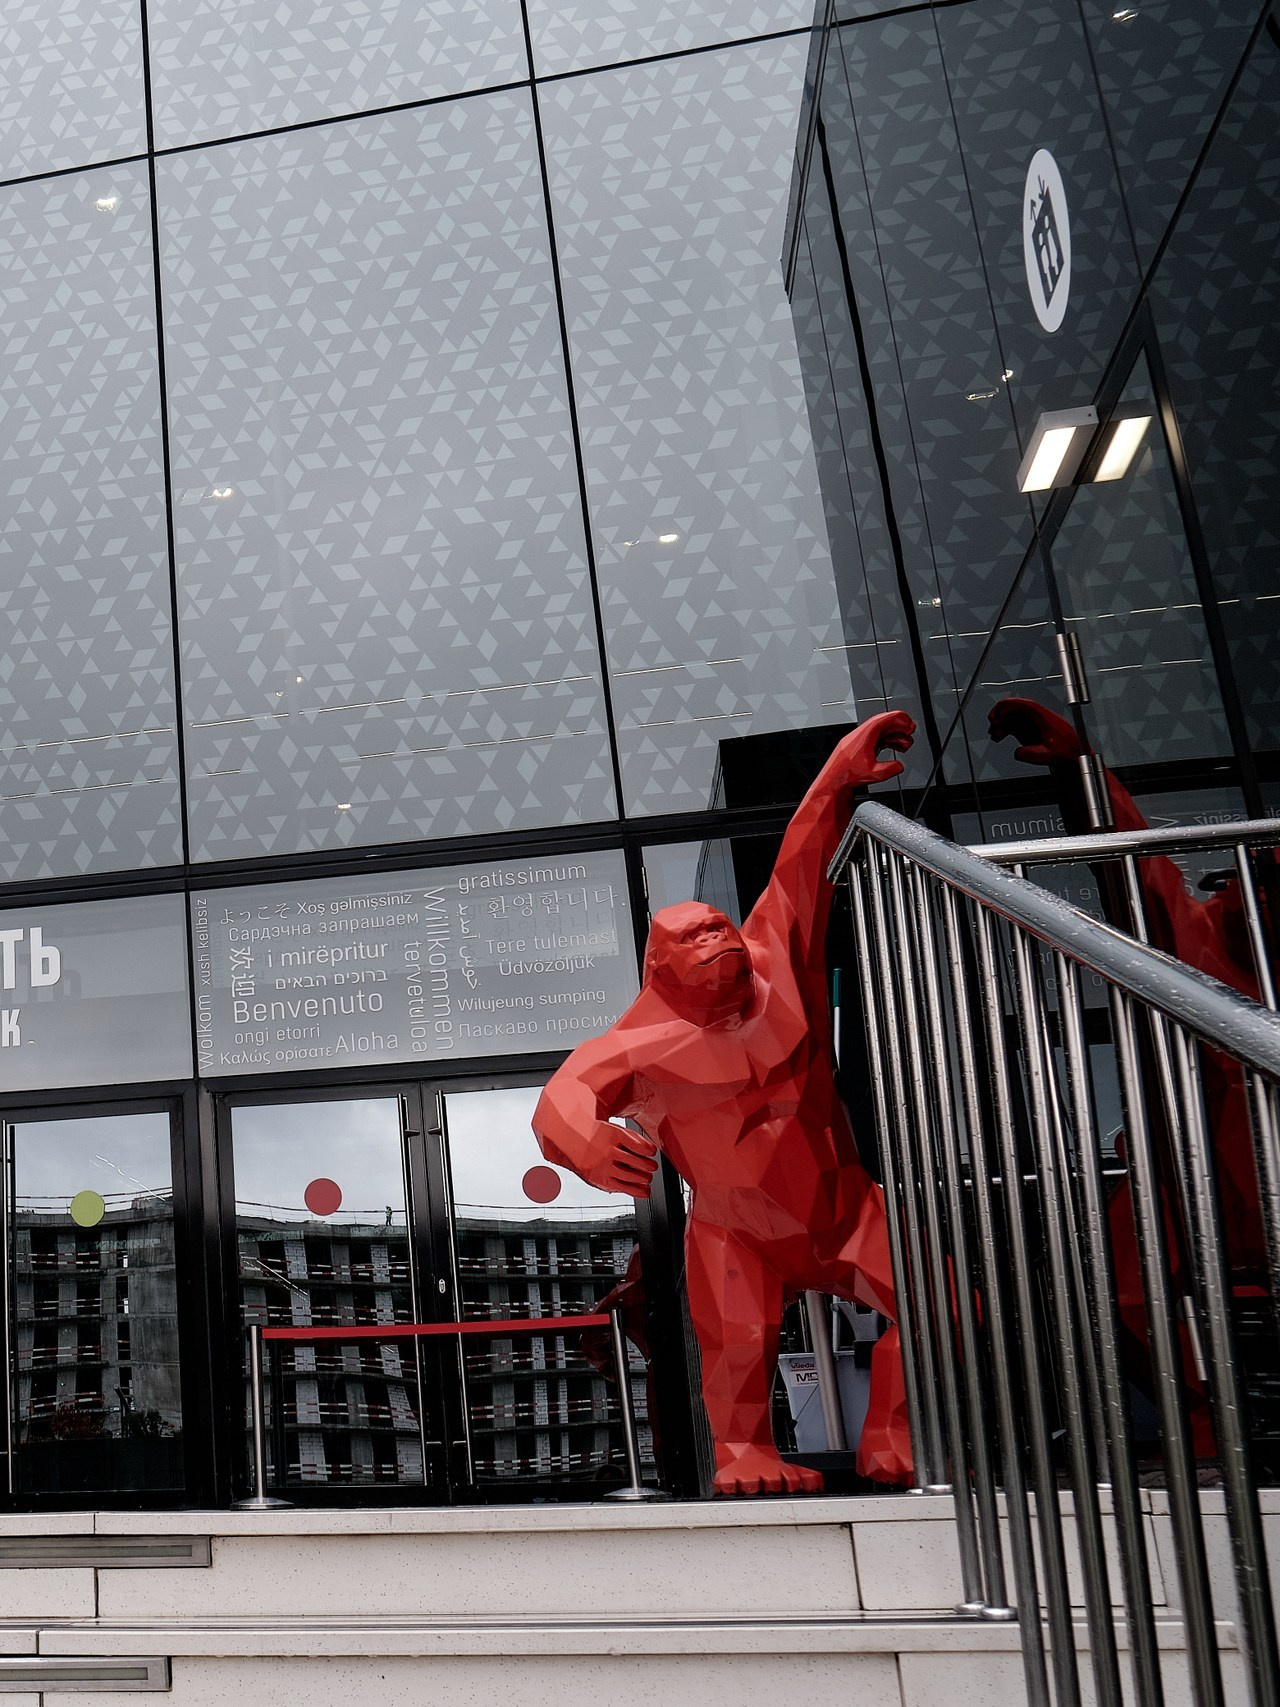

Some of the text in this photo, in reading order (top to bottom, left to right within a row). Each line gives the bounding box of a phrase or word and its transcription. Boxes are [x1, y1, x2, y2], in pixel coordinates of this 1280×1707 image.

[458, 864, 586, 894] gratissimum
[296, 892, 413, 916] Xoş gəlmişsiniz
[229, 912, 419, 943] Сардэчна запрашаем
[485, 928, 618, 954] Tere tulemast
[268, 942, 389, 968] i mirëpritur
[229, 946, 256, 998] 欢迎
[275, 969, 389, 990] ברוכים הבאים
[424, 887, 454, 1050] Willkommen
[195, 898, 214, 1070] Wolkom xush kelibsiz
[404, 940, 430, 1054] tervetuloa
[233, 989, 384, 1024] Benvenuto
[457, 988, 606, 1013] Wilujeung sumping
[234, 1023, 321, 1047] ongi etorri
[335, 1031, 399, 1054] Aloha
[458, 1020, 538, 1039] Ласкаво
[220, 1050, 271, 1066] Καλώς
